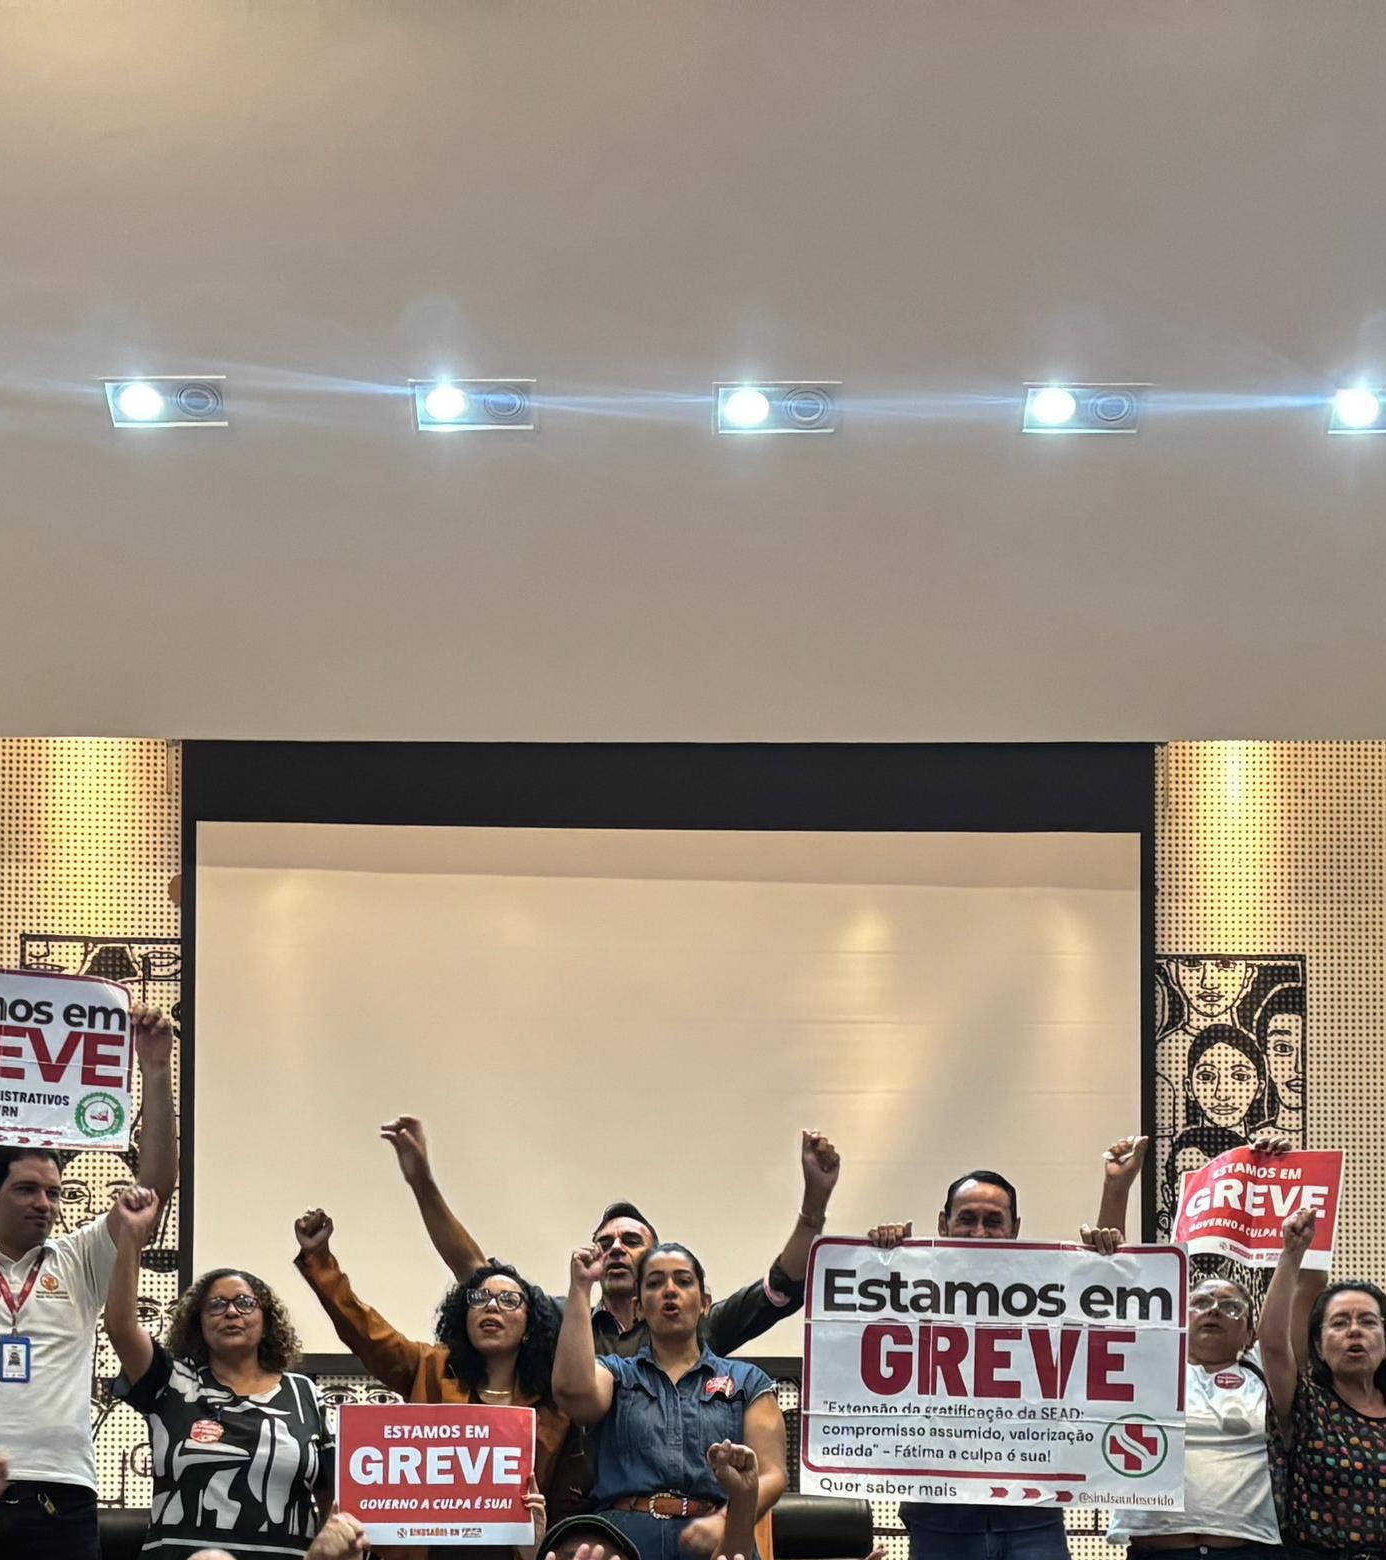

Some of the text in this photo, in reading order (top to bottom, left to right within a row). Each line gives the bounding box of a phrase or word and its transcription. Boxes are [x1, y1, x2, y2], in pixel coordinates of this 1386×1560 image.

[64, 1003, 126, 1032] em
[1212, 1162, 1302, 1180] ESTAMOS EM
[1185, 1178, 1329, 1219] GREVE
[1245, 1228, 1278, 1239] CULPA
[823, 1268, 1173, 1322] Estamos em
[860, 1318, 1137, 1401] GREVE
[924, 1403, 1013, 1421] gratificação
[1017, 1405, 1037, 1420] da
[384, 1425, 489, 1439] ESTAMOS EM
[822, 1422, 1094, 1446] compromisso assumido, valorização
[894, 1444, 944, 1461] Fátima
[948, 1450, 957, 1461] a
[960, 1446, 1003, 1465] culpa
[1019, 1448, 1051, 1464] sua!
[349, 1446, 522, 1485] GREVE
[819, 1478, 957, 1497] Quer saber mais
[359, 1495, 513, 1510] GOVERNO A CULPA É SUA!
